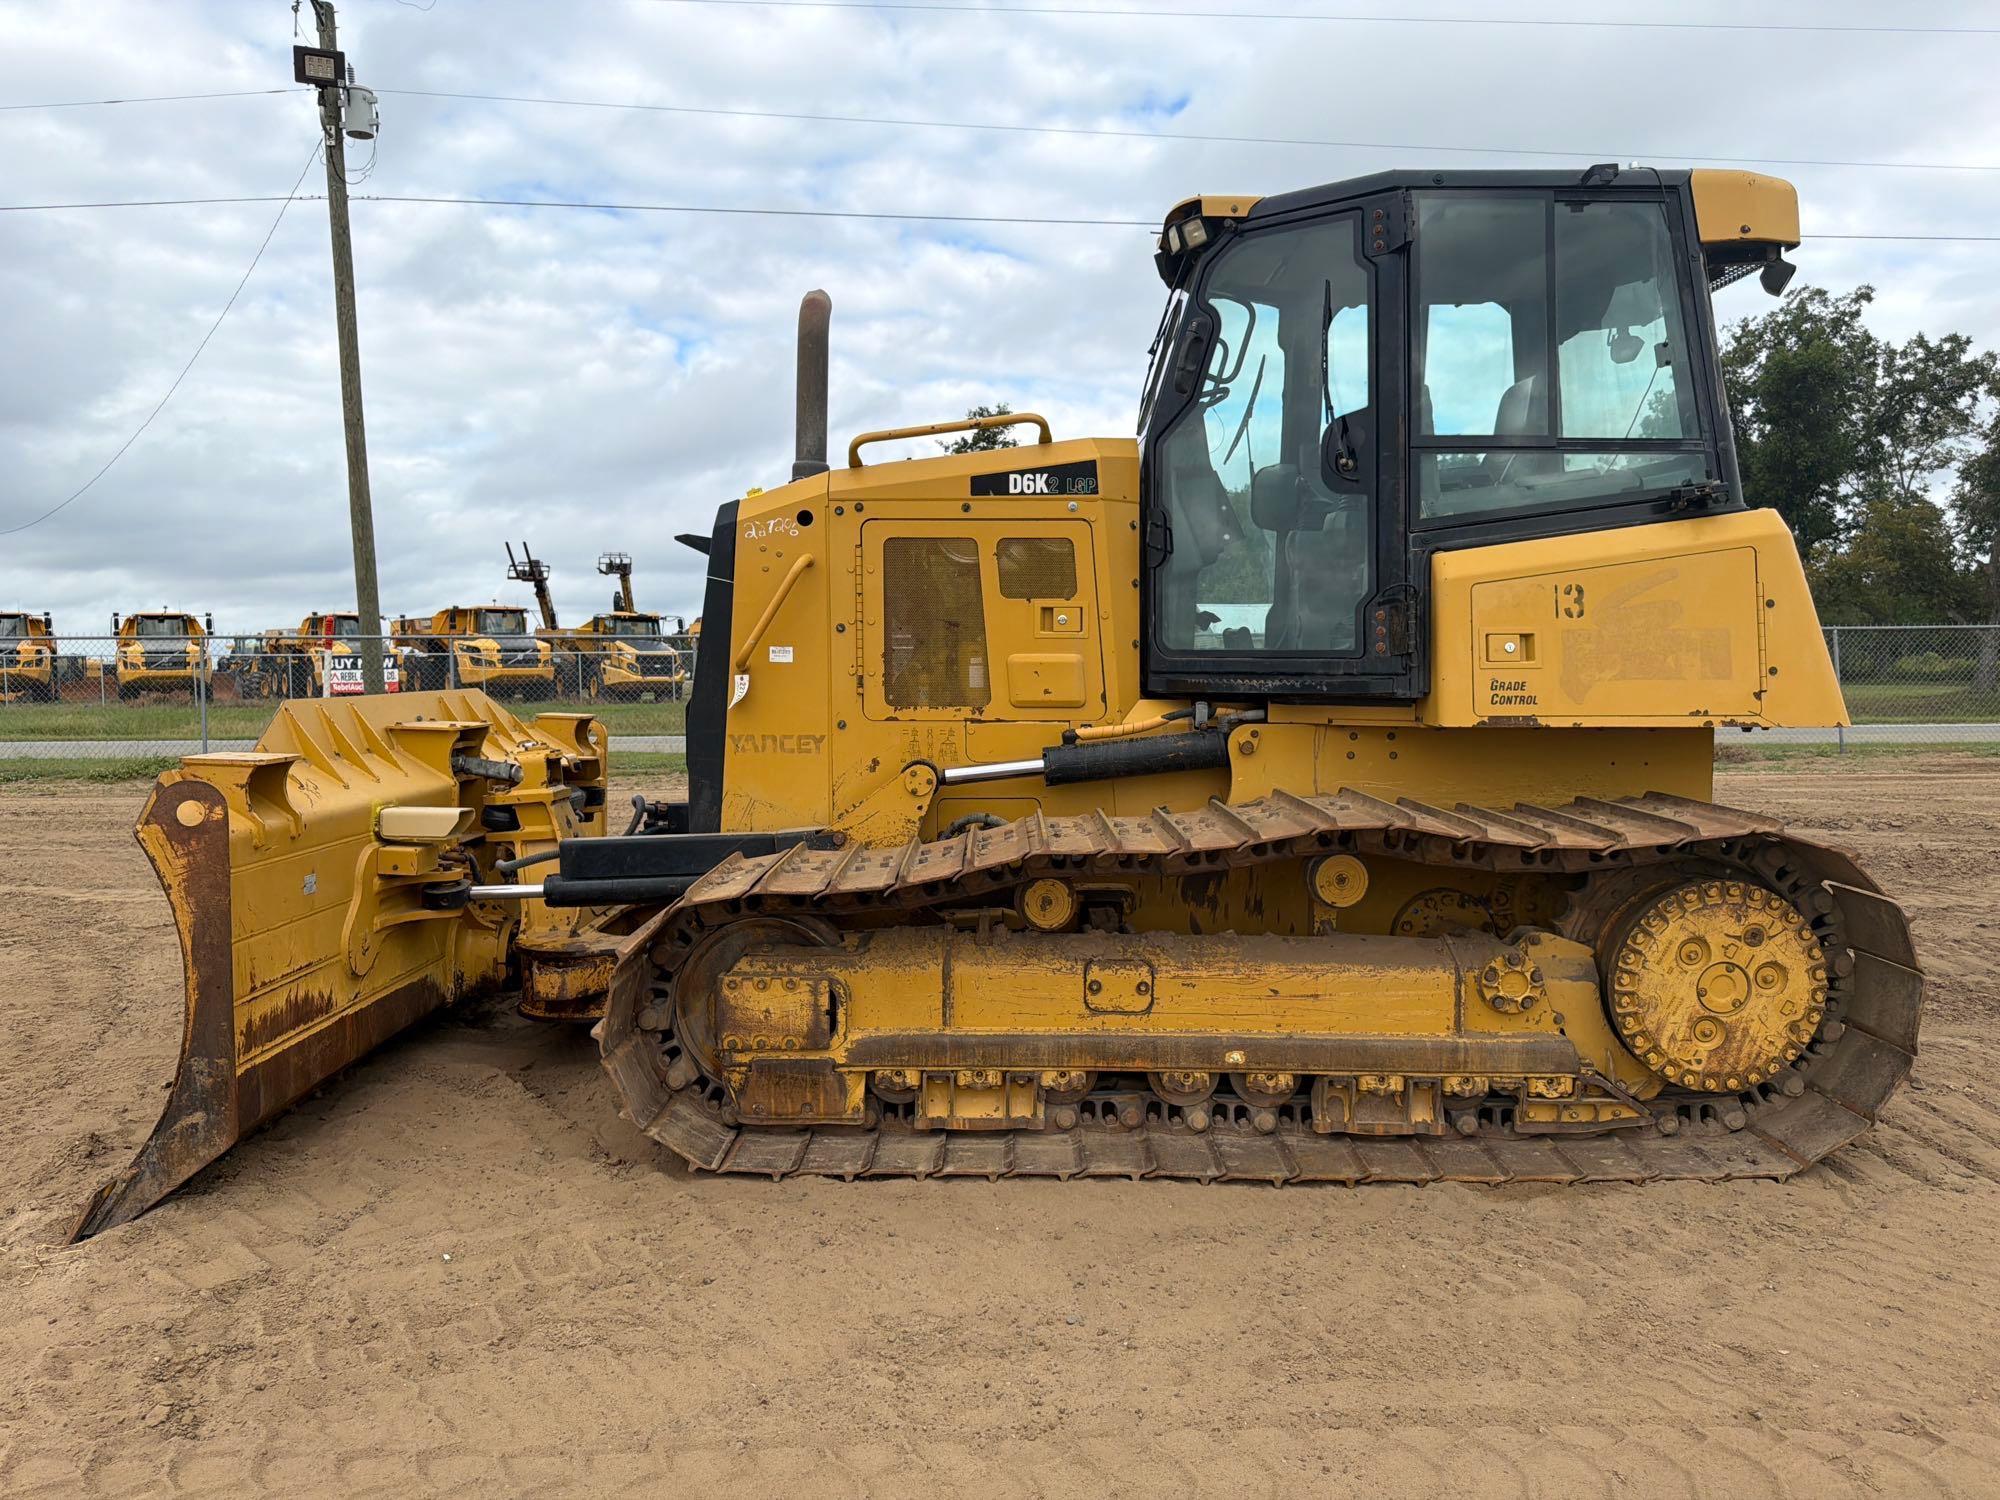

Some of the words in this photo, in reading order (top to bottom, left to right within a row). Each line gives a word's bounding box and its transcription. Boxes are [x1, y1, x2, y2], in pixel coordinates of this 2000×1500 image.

[1066, 477, 1097, 494] LGP
[1554, 584, 1585, 619] 13
[1490, 679, 1527, 692] GRADE
[1490, 693, 1539, 706] CONTROL
[728, 734, 827, 754] YANCEY
